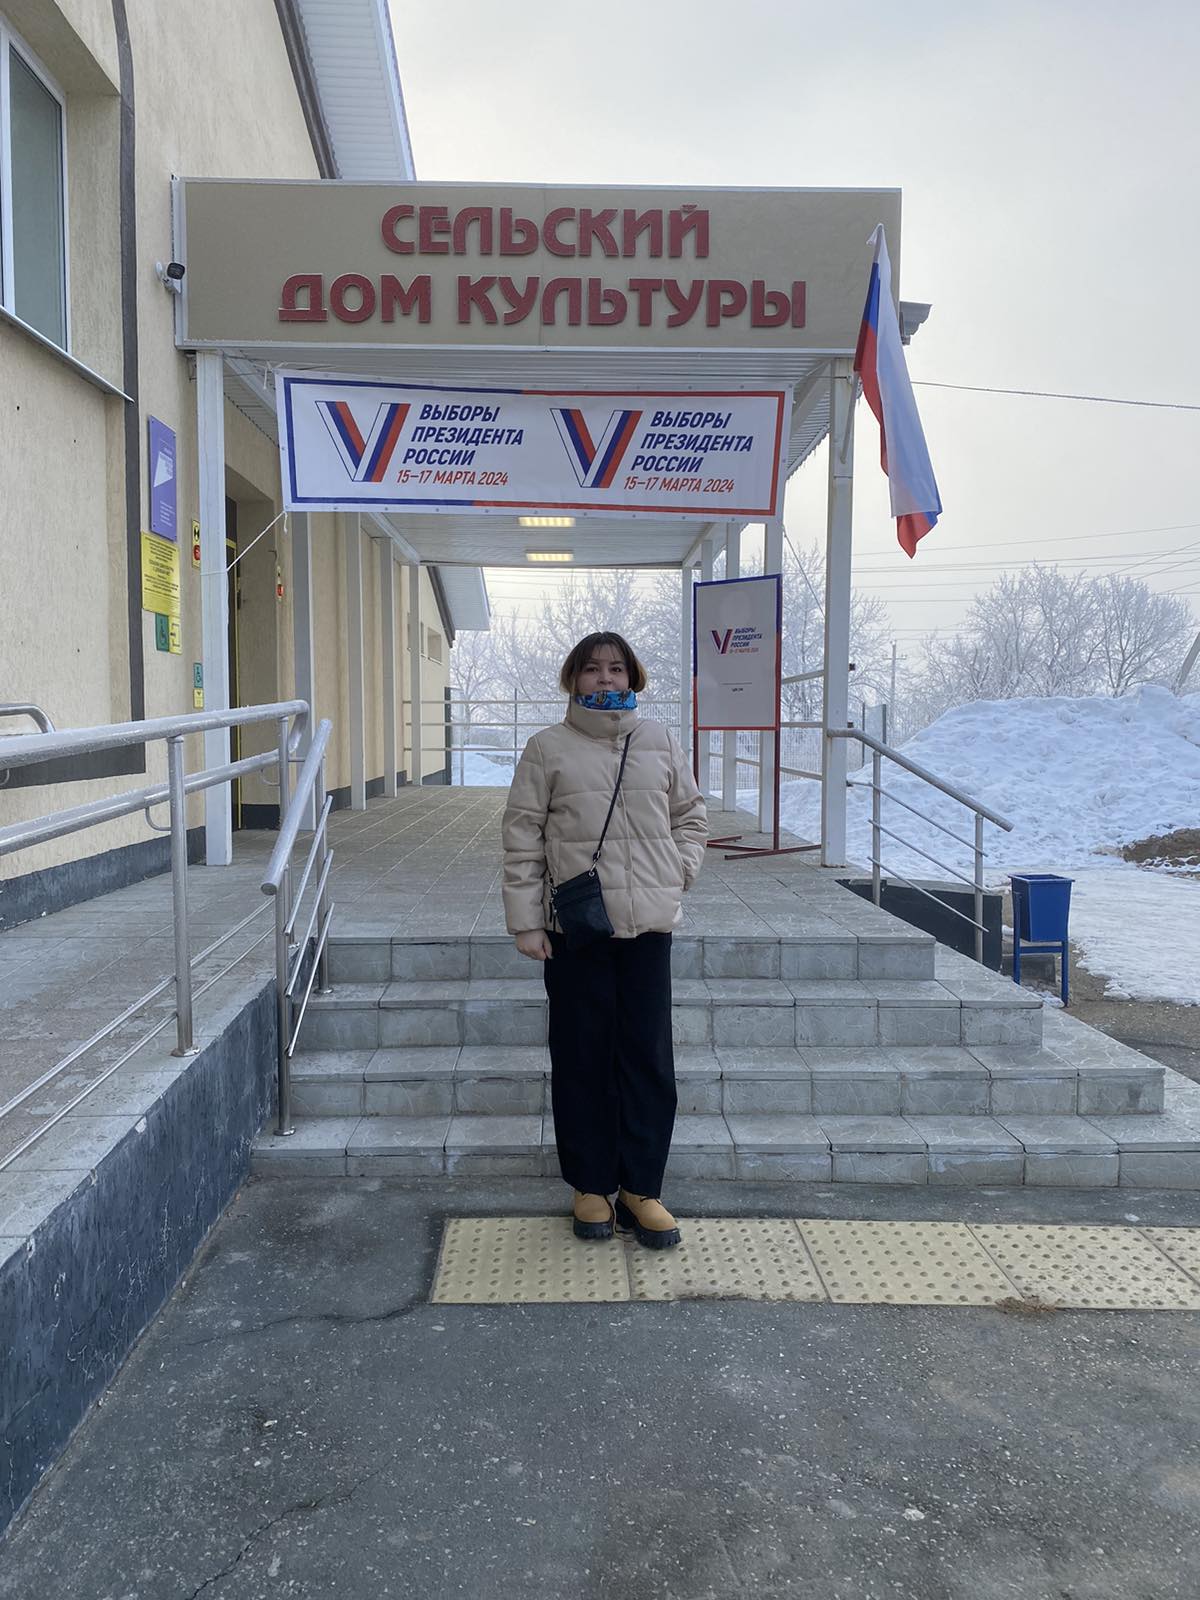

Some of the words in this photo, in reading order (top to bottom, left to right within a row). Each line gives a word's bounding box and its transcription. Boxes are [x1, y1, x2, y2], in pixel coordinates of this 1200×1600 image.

[381, 203, 710, 259] СЕЛЬСКИЙ
[278, 273, 432, 324] ДОМ
[457, 275, 806, 329] КУЛЬТУРЫ
[419, 403, 501, 423] ВЫБОРЫ
[650, 410, 733, 429] ВЫБОРЫ
[411, 426, 524, 447] ПРЕЗИДЕНТА
[640, 432, 754, 453] ПРЕЗИДЕНТА
[402, 448, 476, 466] РОССИИ
[631, 454, 704, 473] РОССИИ
[433, 470, 477, 486] МАРТА
[478, 471, 508, 486] 2024
[659, 476, 703, 493] МАРТА
[703, 477, 735, 493] 2024
